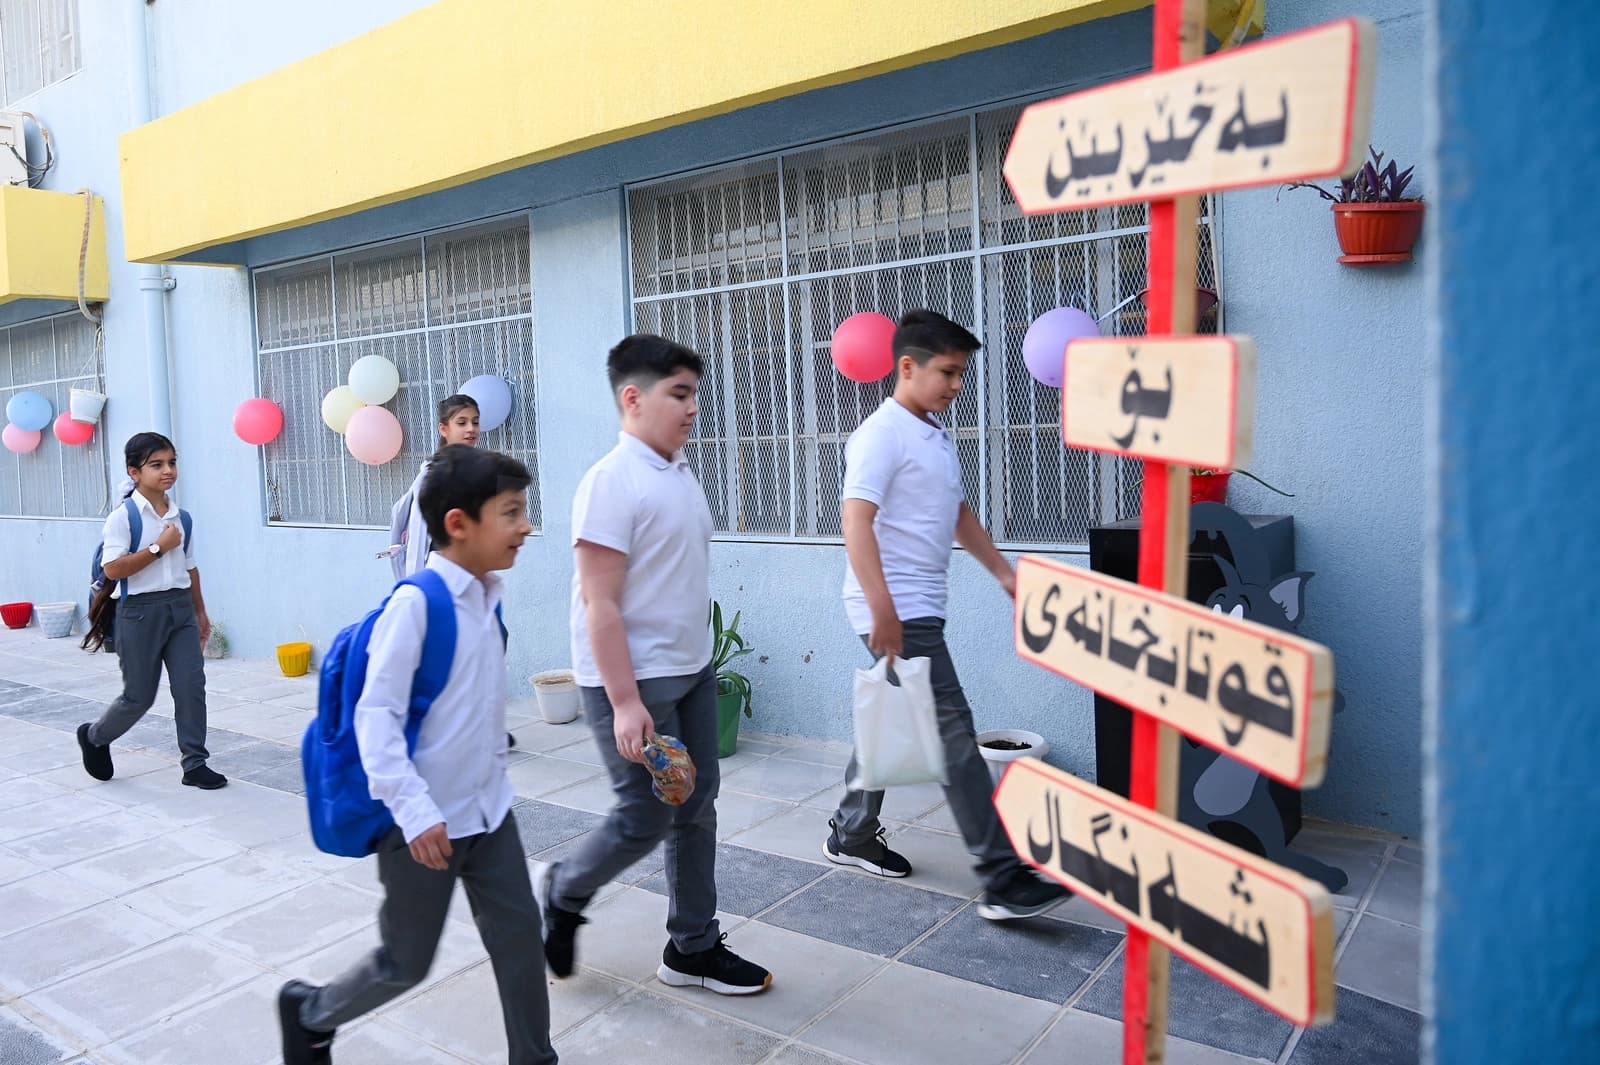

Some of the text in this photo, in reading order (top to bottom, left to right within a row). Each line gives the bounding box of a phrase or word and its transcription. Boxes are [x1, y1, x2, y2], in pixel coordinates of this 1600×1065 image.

[1109, 344, 1173, 450] بۆ
[1021, 583, 1295, 747] قوتابخانەی
[1028, 786, 1271, 992] شەنگال
